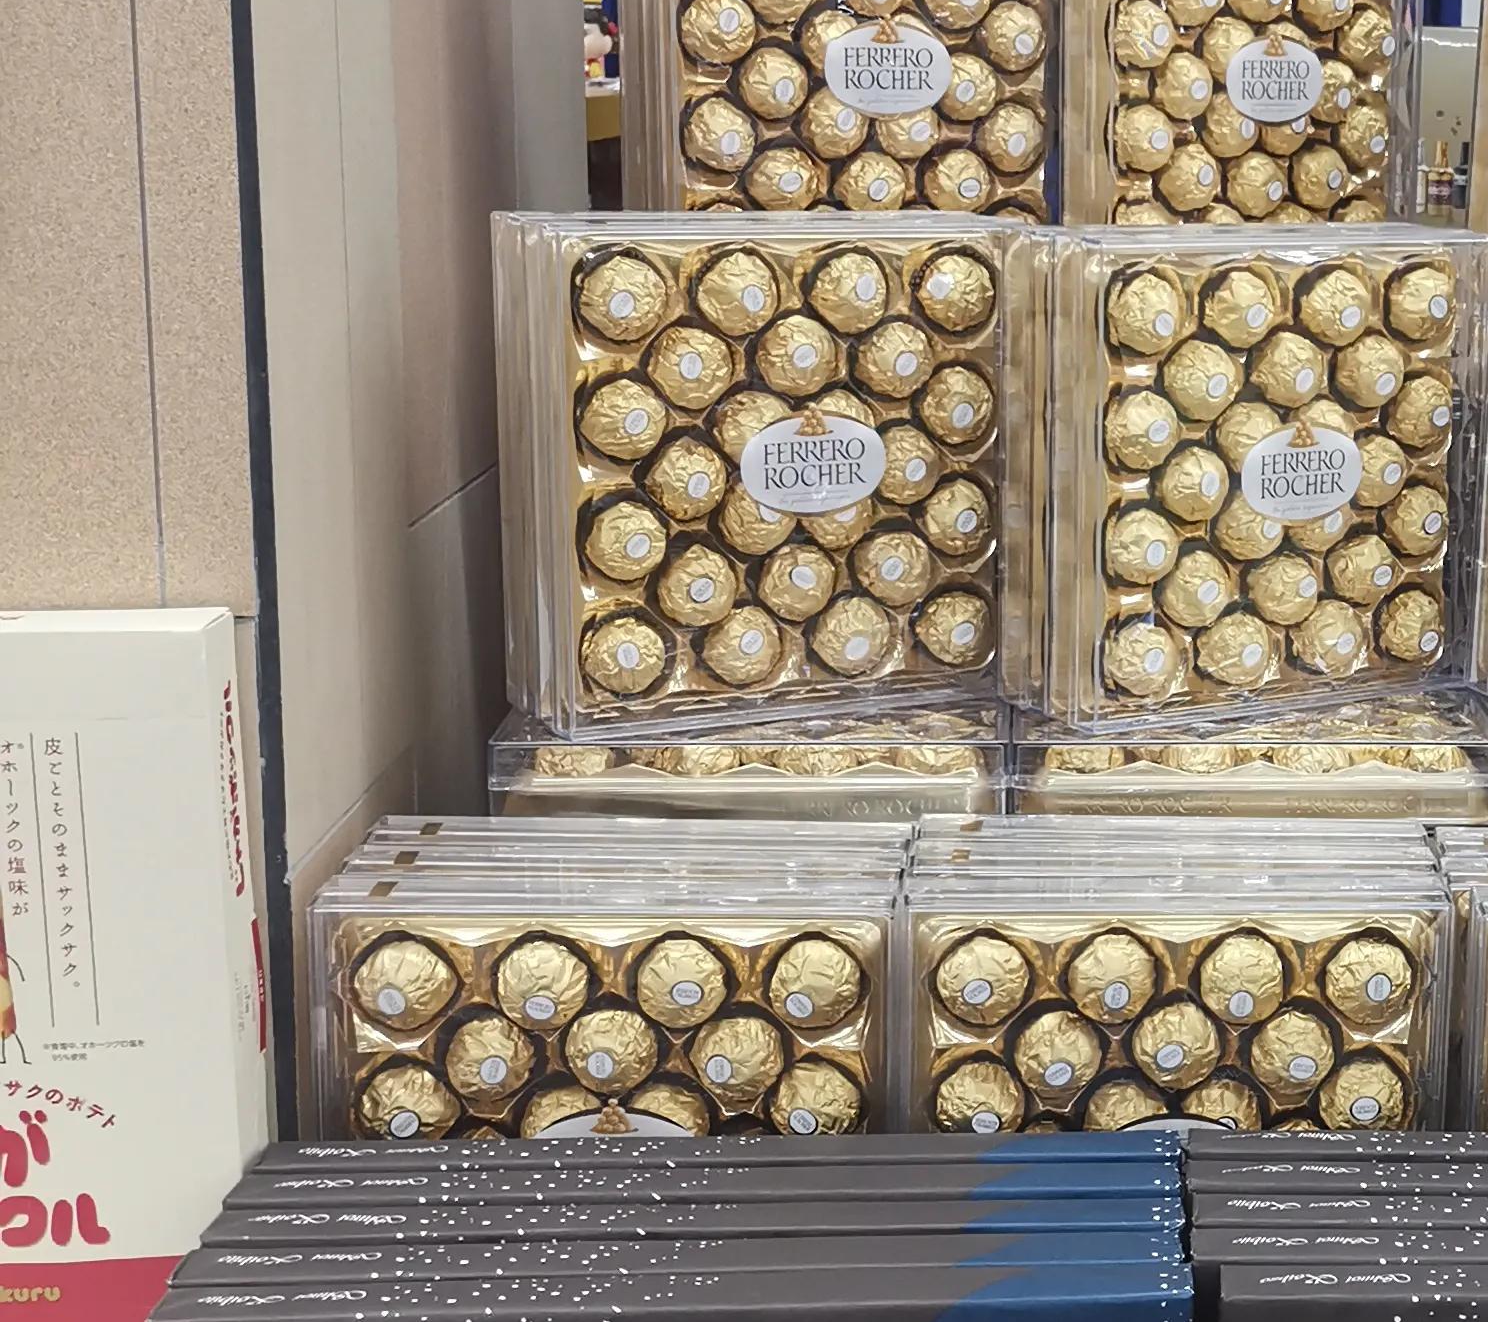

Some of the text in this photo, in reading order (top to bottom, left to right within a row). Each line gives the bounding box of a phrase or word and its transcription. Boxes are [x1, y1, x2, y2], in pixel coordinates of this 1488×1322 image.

[844, 47, 933, 68] FERRERO
[1242, 60, 1310, 79] FERRERO
[845, 69, 934, 90] ROCHER
[1242, 80, 1309, 101] ROCHER
[764, 438, 865, 465] FERRERO
[1261, 448, 1346, 476] FERRERO
[764, 462, 867, 490] ROCHER
[1261, 472, 1346, 499] ROCHER
